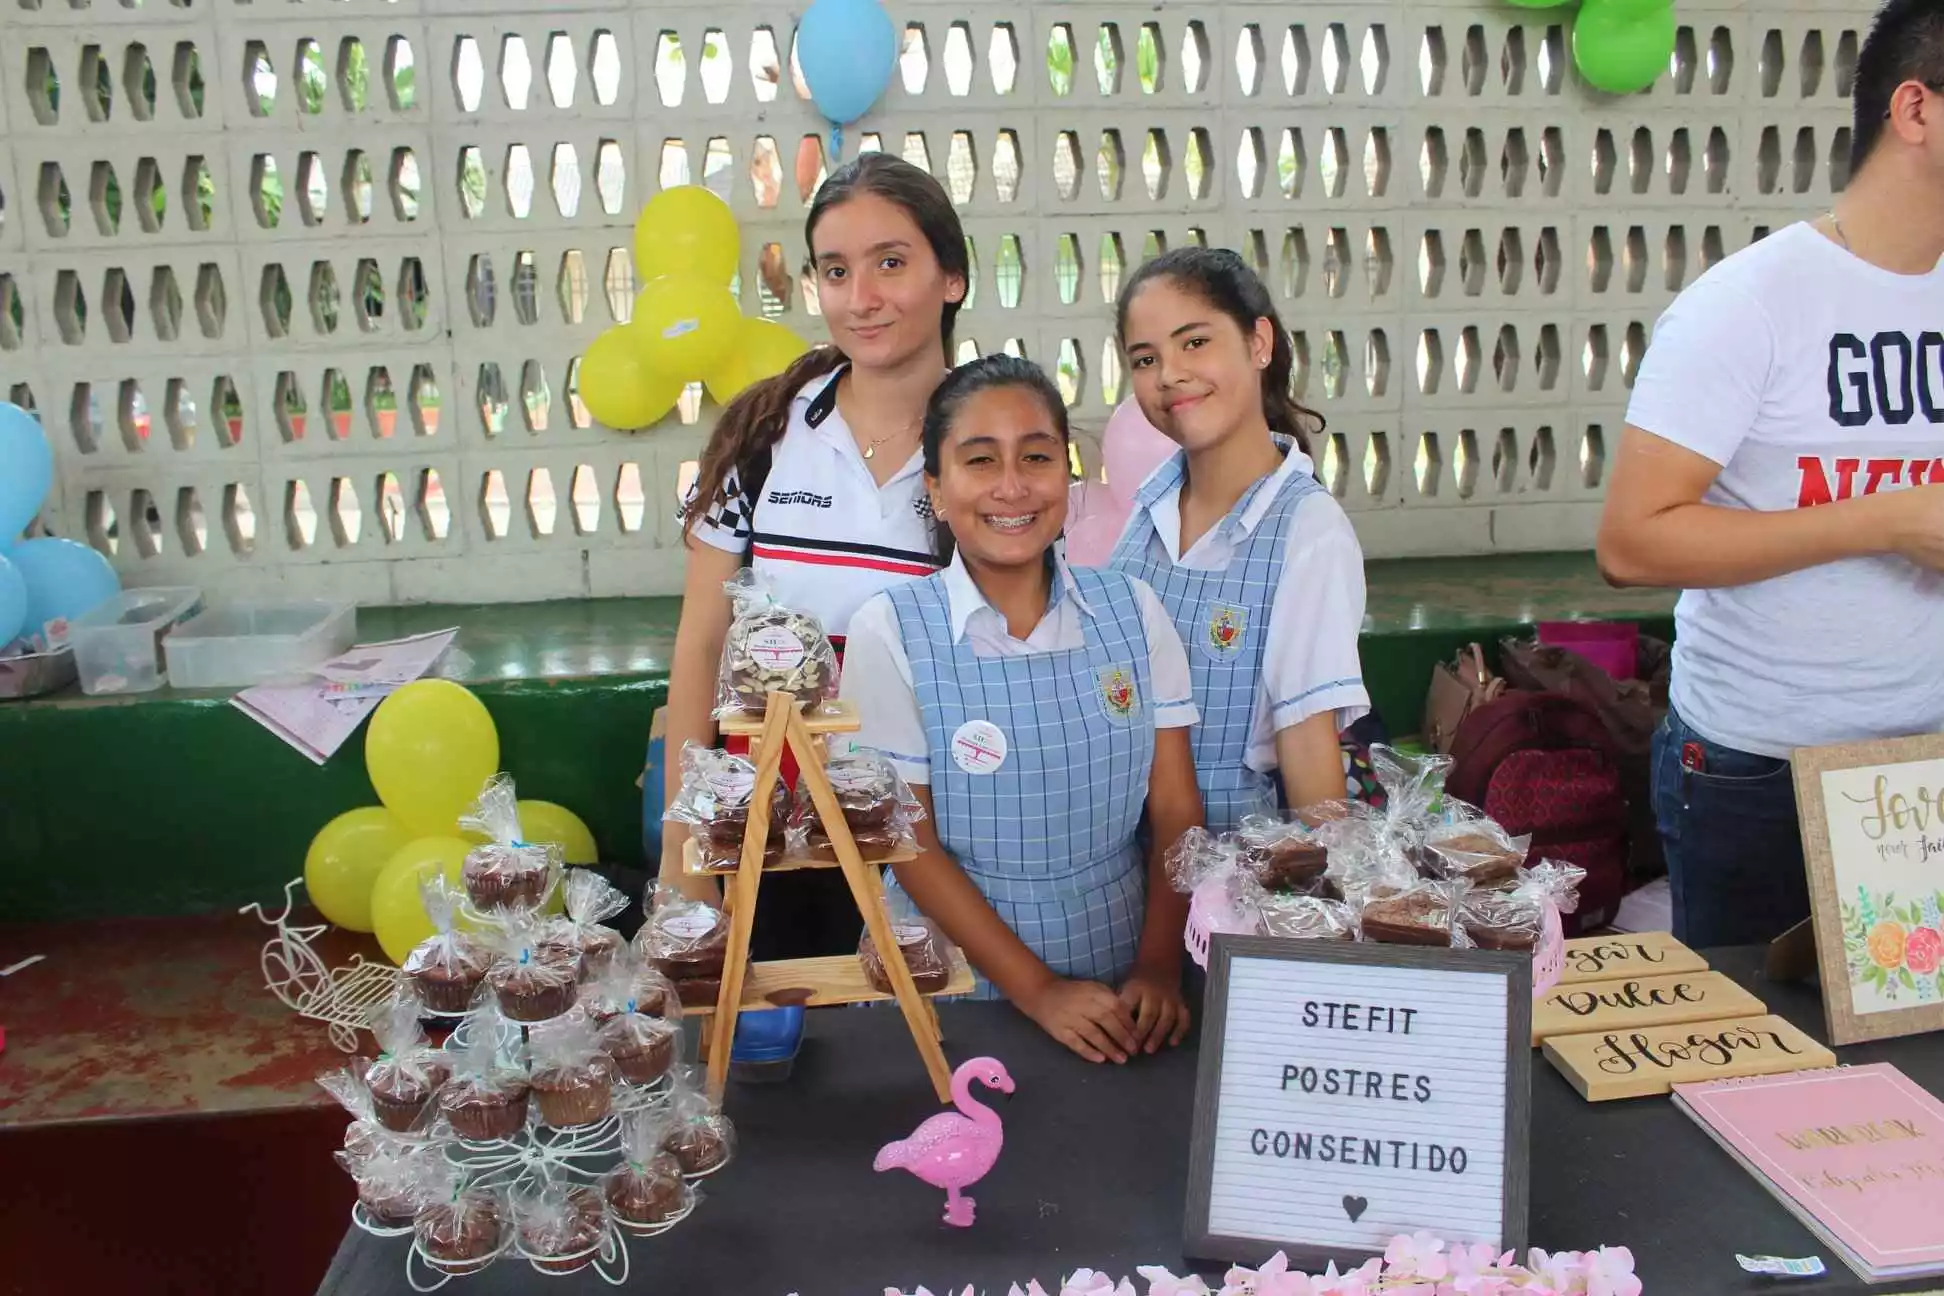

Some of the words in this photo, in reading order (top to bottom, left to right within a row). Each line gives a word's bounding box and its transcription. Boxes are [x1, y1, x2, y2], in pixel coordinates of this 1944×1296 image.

[1841, 775, 1944, 839] Lov
[1302, 1001, 1418, 1035] STEFIT
[1547, 982, 1704, 1015] Dulce
[1594, 1027, 1802, 1074] Hogar
[1281, 1064, 1432, 1103] POSTRES
[1250, 1128, 1468, 1174] CONSENTIDO
